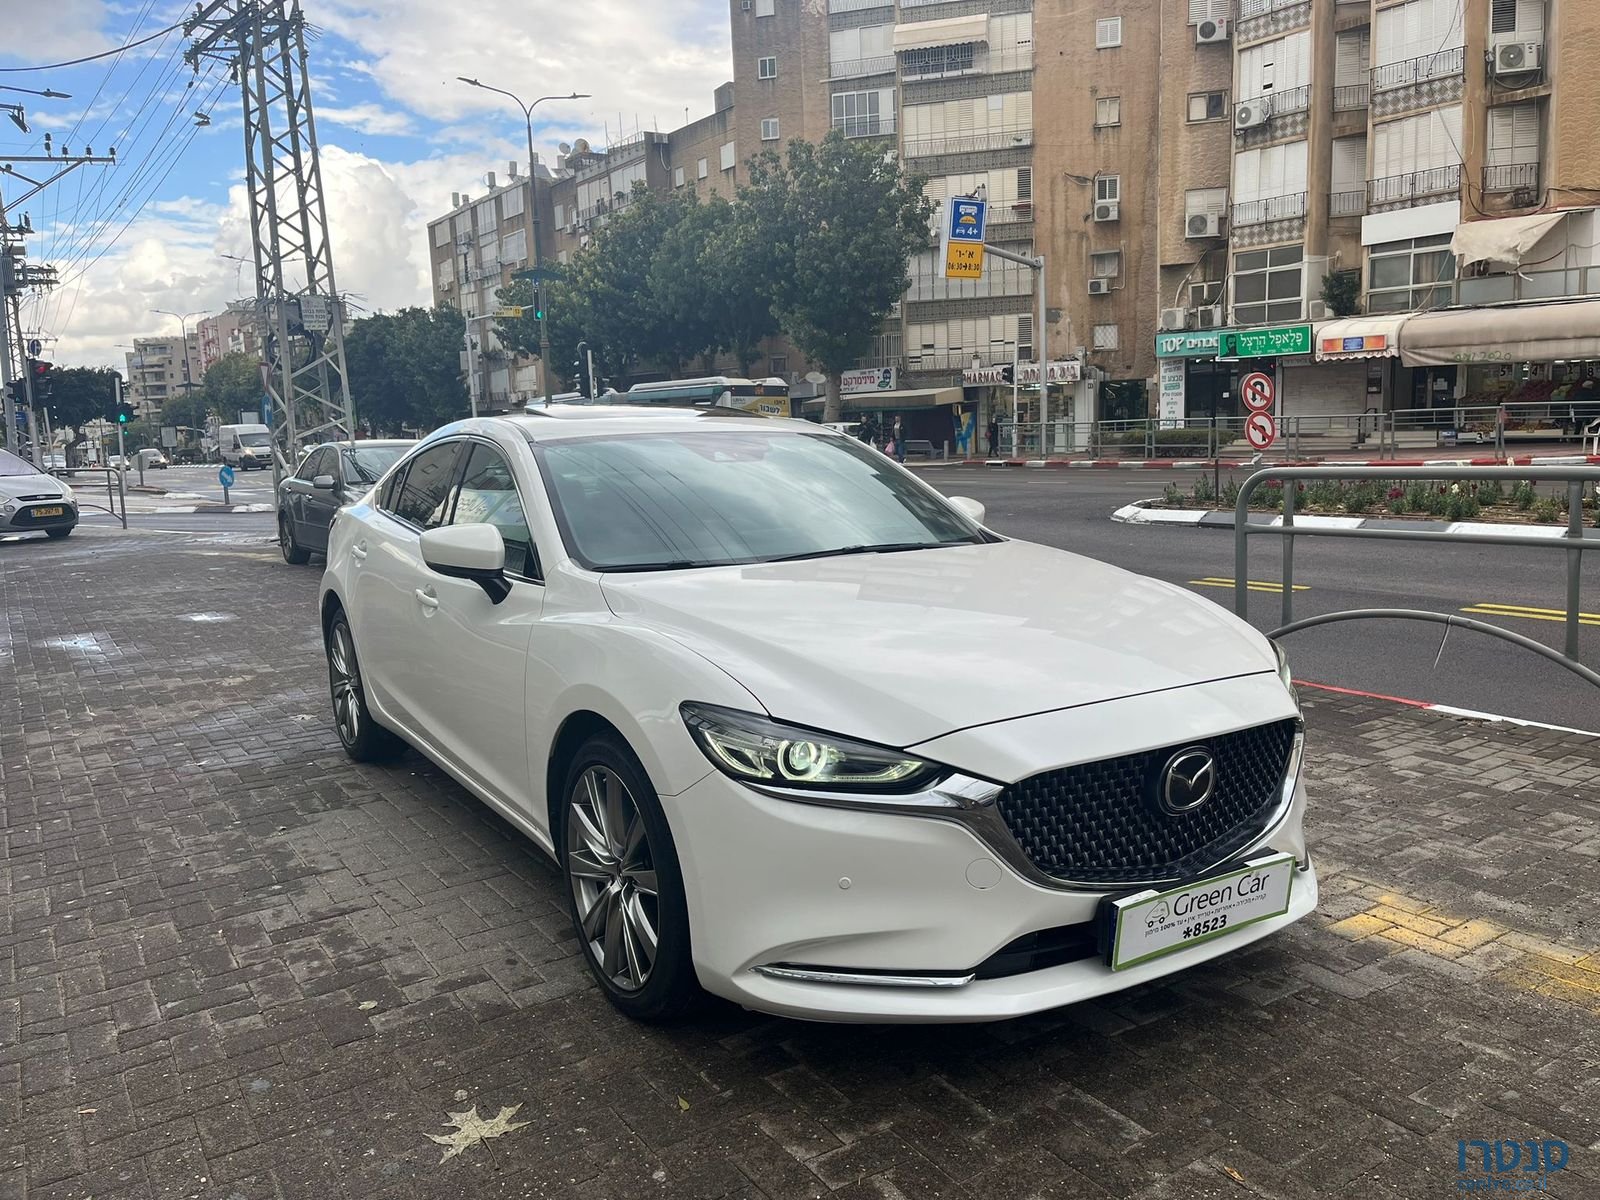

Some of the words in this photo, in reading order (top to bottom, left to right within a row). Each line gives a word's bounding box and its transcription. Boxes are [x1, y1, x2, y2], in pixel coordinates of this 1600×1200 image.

[967, 227, 978, 236] 4+
[948, 262, 963, 271] 06:30
[1160, 336, 1185, 353] TOP
[1500, 366, 1506, 376] 5
[1532, 366, 1538, 376] 4
[1587, 367, 1594, 377] 8
[842, 375, 875, 387] מינימרקט
[963, 371, 1002, 384] PHARMAC
[759, 404, 780, 414] לשבור
[1173, 886, 1232, 917] Green
[1237, 873, 1270, 897] Car
[1236, 898, 1252, 907] מכירה
[1214, 903, 1233, 914] אחריות
[1160, 921, 1176, 932] 100%
